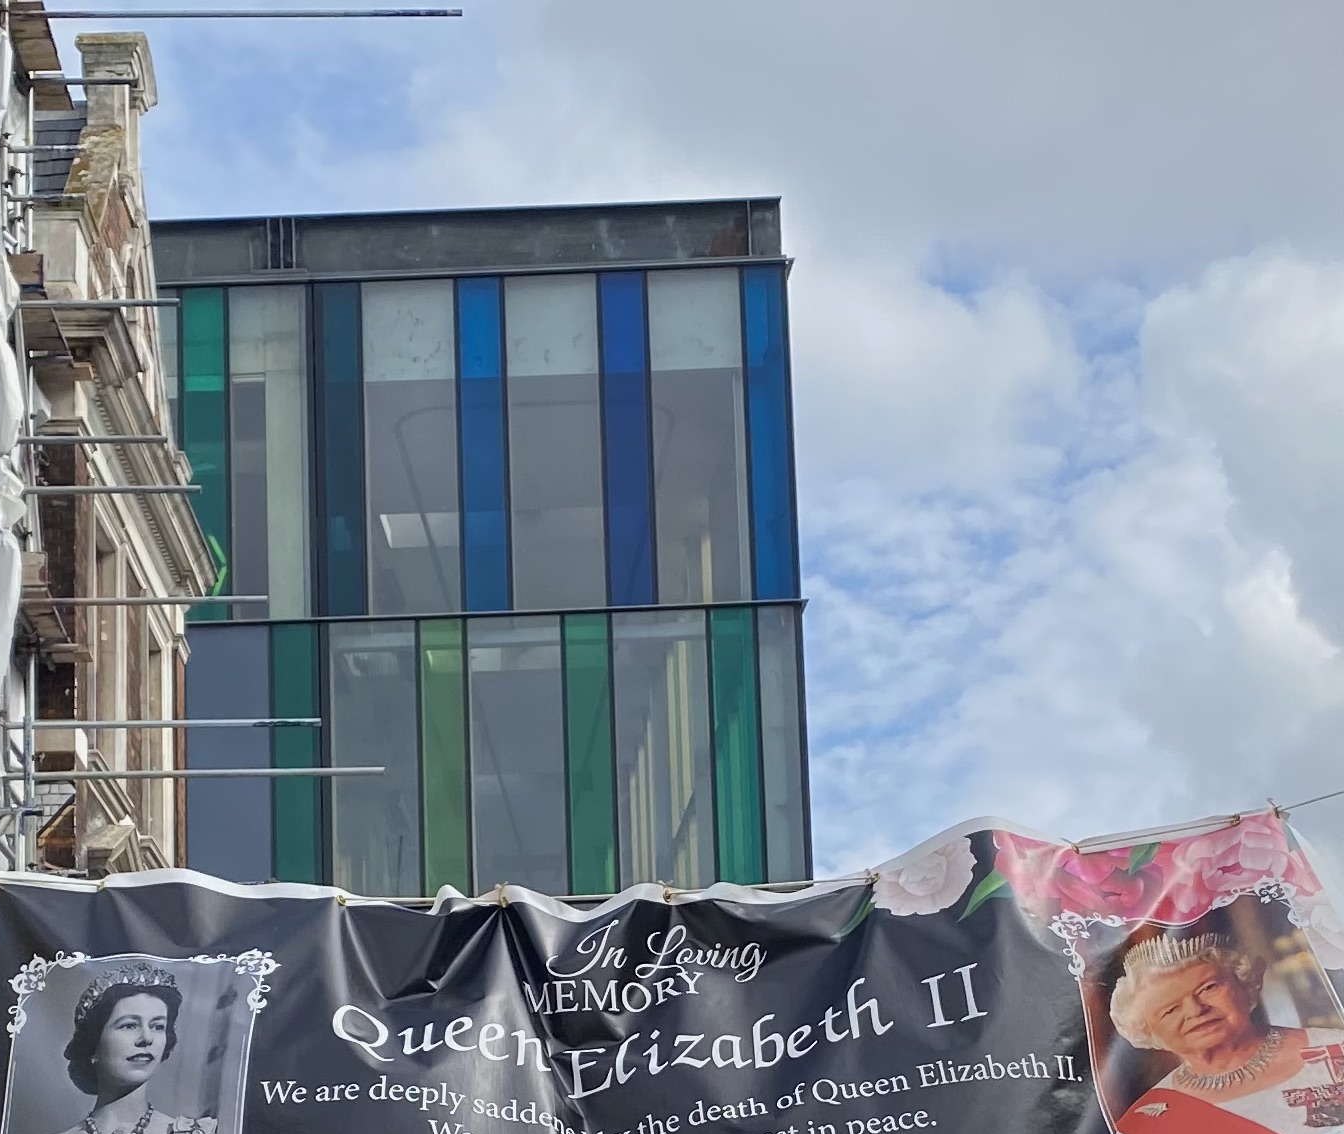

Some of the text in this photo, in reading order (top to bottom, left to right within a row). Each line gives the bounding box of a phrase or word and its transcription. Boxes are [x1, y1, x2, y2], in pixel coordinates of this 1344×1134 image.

[546, 919, 767, 983] In Loving
[523, 971, 704, 1016] MEMORY
[332, 962, 988, 1099] Queen Elizabeth II
[260, 1081, 307, 1104] We
[315, 1080, 359, 1102] are
[369, 1076, 466, 1115] deeply
[688, 1098, 768, 1126] death
[776, 1083, 805, 1110] of
[811, 1074, 910, 1105] Queen
[916, 1053, 1050, 1088] Elizabeth
[1053, 1054, 1083, 1082] II.
